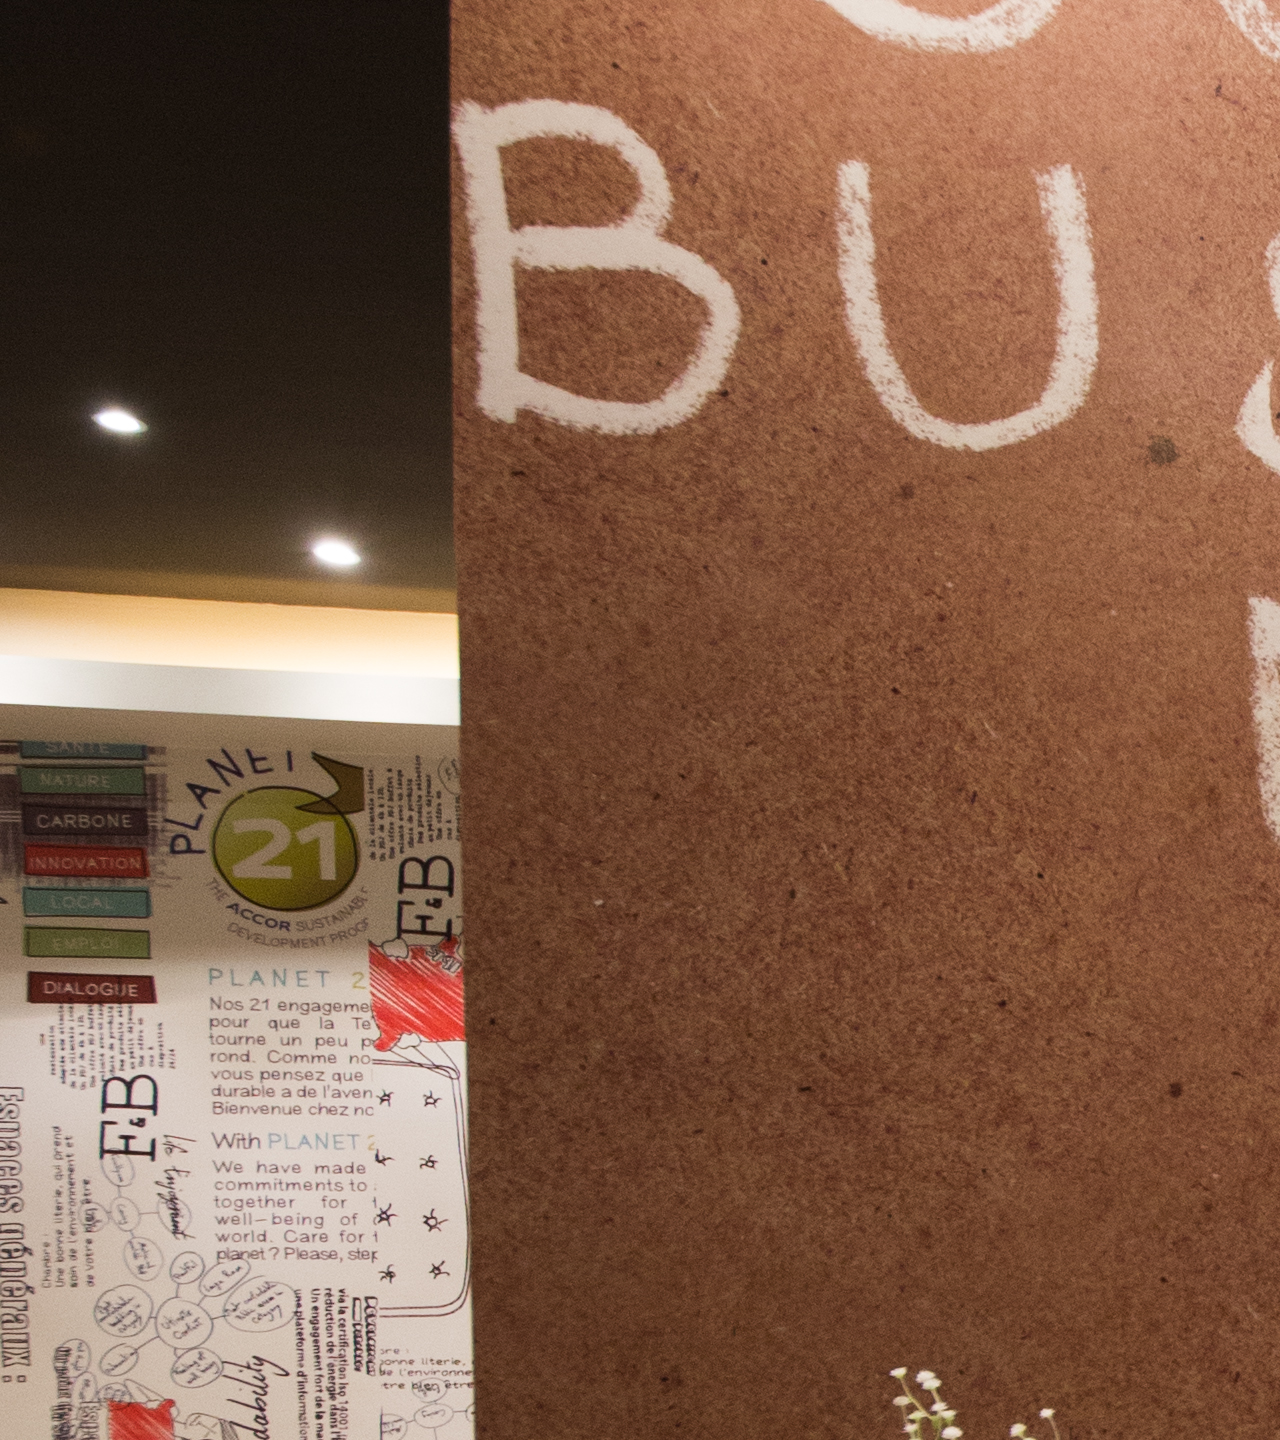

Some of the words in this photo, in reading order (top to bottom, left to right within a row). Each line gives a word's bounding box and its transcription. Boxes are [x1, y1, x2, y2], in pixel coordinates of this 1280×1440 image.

[39, 773, 111, 789] NATURE
[36, 813, 133, 829] CARBONE
[232, 817, 337, 881] 21
[29, 856, 142, 871] INNOVATION
[50, 896, 115, 911] LOCAL
[225, 902, 291, 932] ACCOR
[226, 917, 324, 949] DEVELOPMENT
[208, 967, 331, 988] PLANET
[43, 980, 140, 998] DIALOGUE
[209, 996, 245, 1012] Nos
[249, 998, 270, 1012] 21
[209, 1017, 250, 1034] pour
[268, 1017, 301, 1034] que
[319, 1016, 335, 1030] la
[208, 1034, 267, 1047] tourne
[280, 1036, 303, 1047] un
[315, 1036, 349, 1052] peu
[210, 1051, 256, 1064] rond.
[267, 1051, 338, 1064] Comme
[211, 1071, 255, 1082] vous
[260, 1071, 325, 1087] pensez
[332, 1071, 364, 1087] que
[211, 1085, 276, 1099] durable
[281, 1088, 292, 1099] a
[296, 1085, 318, 1099] de
[212, 1102, 302, 1117] Bienvenue
[308, 1103, 350, 1116] chez
[50, 1126, 63, 1161] prend
[211, 1131, 262, 1151] With
[267, 1132, 360, 1151] PLANET
[212, 1160, 245, 1174] We
[256, 1160, 302, 1174] have
[314, 1161, 367, 1175] made
[214, 1178, 344, 1192] commitments
[350, 1179, 368, 1192] to
[214, 1195, 296, 1213] together
[321, 1195, 347, 1209] for
[340, 1212, 359, 1226] of
[54, 1228, 64, 1263] bonne
[215, 1229, 274, 1244] world.
[284, 1229, 329, 1244] Care
[340, 1229, 364, 1244] for
[83, 1238, 95, 1272] votre
[284, 1247, 344, 1263] Please,
[310, 1288, 321, 1304] Un
[336, 1288, 348, 1304] via
[323, 1287, 336, 1338] réduction
[293, 1310, 306, 1369] plateforme
[308, 1305, 323, 1372] engagement
[337, 1317, 348, 1380] certification
[313, 1373, 324, 1394] fort
